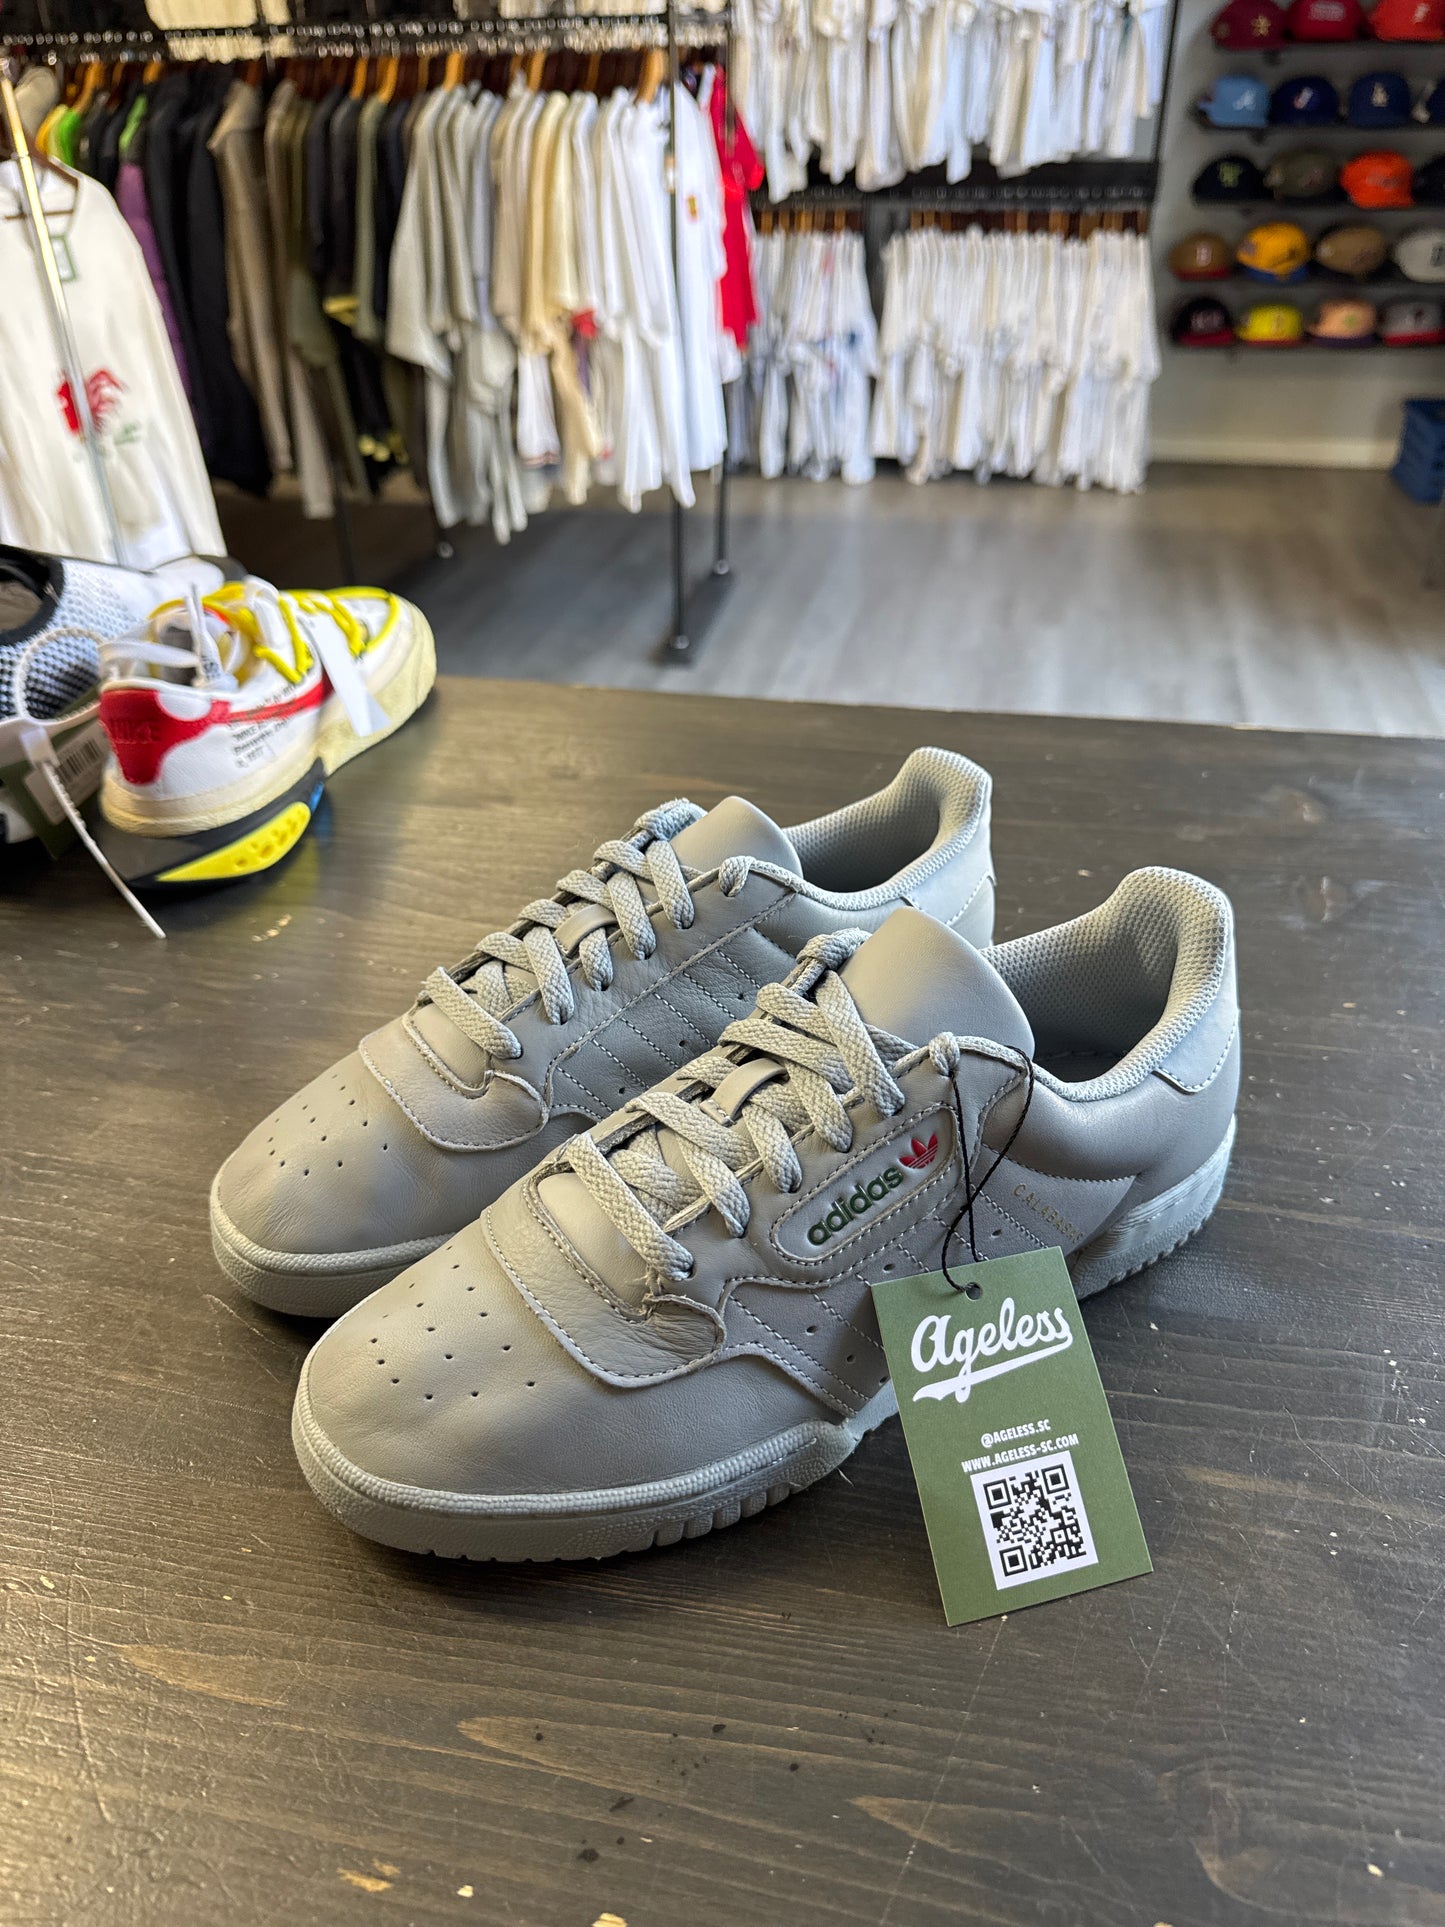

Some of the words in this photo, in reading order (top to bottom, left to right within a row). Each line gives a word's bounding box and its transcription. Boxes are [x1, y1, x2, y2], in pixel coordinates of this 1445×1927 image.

[807, 1166, 904, 1246] adidas
[911, 1297, 1073, 1403] Ageless
[961, 1433, 1080, 1473] WWW.AGELESS-SC.COM
[981, 1418, 1052, 1448] @AGELESS.SC
